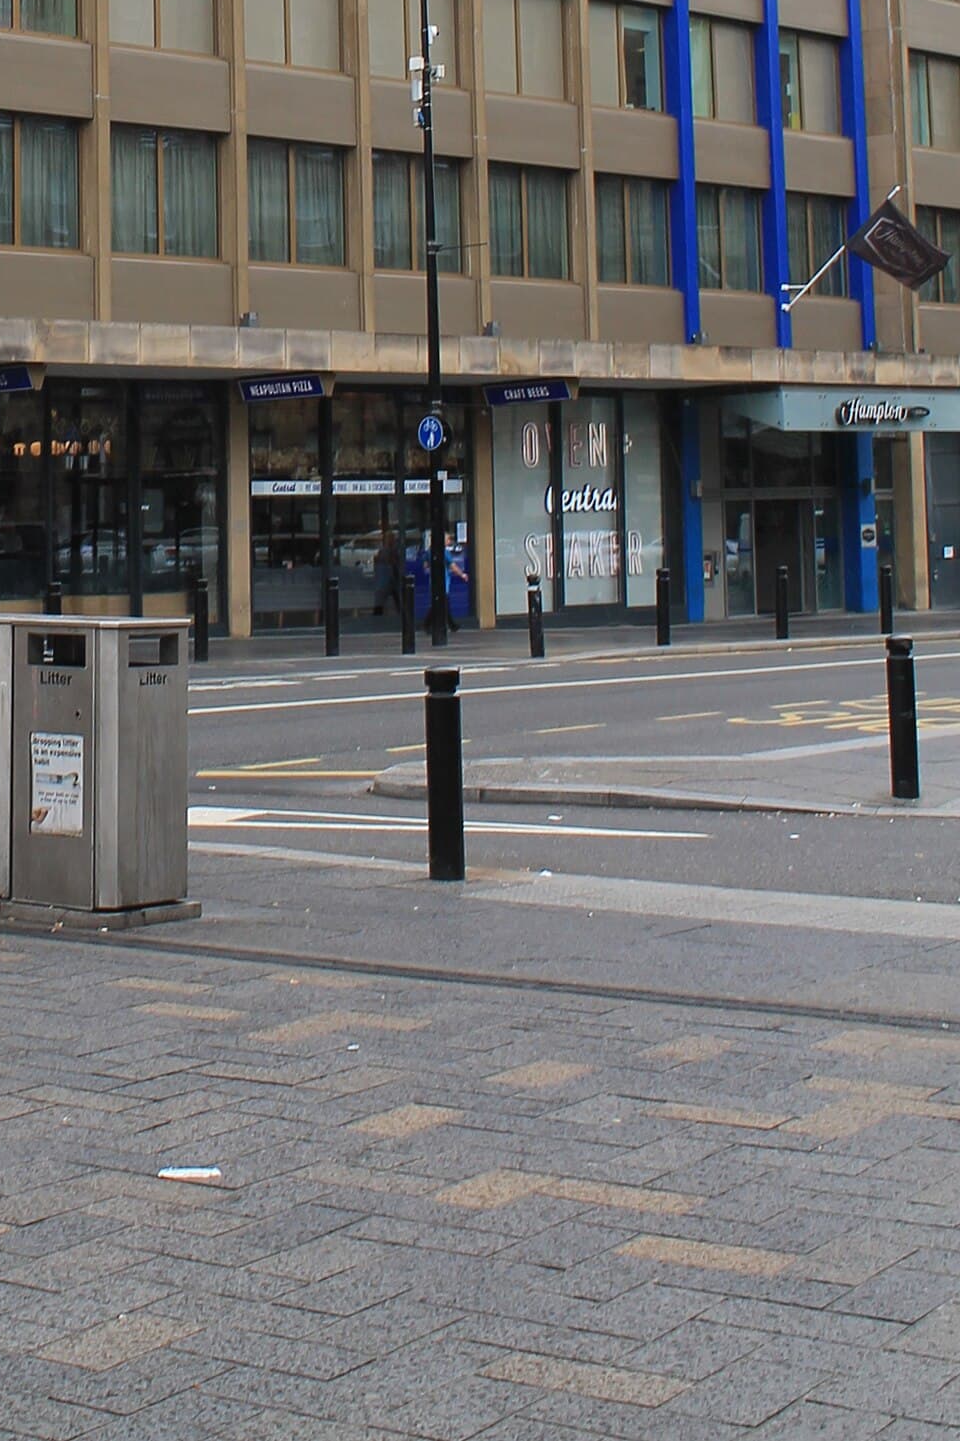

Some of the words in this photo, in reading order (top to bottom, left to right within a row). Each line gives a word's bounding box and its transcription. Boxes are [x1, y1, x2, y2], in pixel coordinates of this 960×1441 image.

[249, 382, 292, 397] NEAPOLITAN
[292, 379, 313, 392] PIZZA
[504, 388, 526, 400] CRAFT
[527, 385, 550, 398] BEERS
[840, 398, 908, 425] Hampton
[546, 484, 617, 513] entra
[40, 671, 72, 686] Litter
[139, 672, 168, 687] Litter
